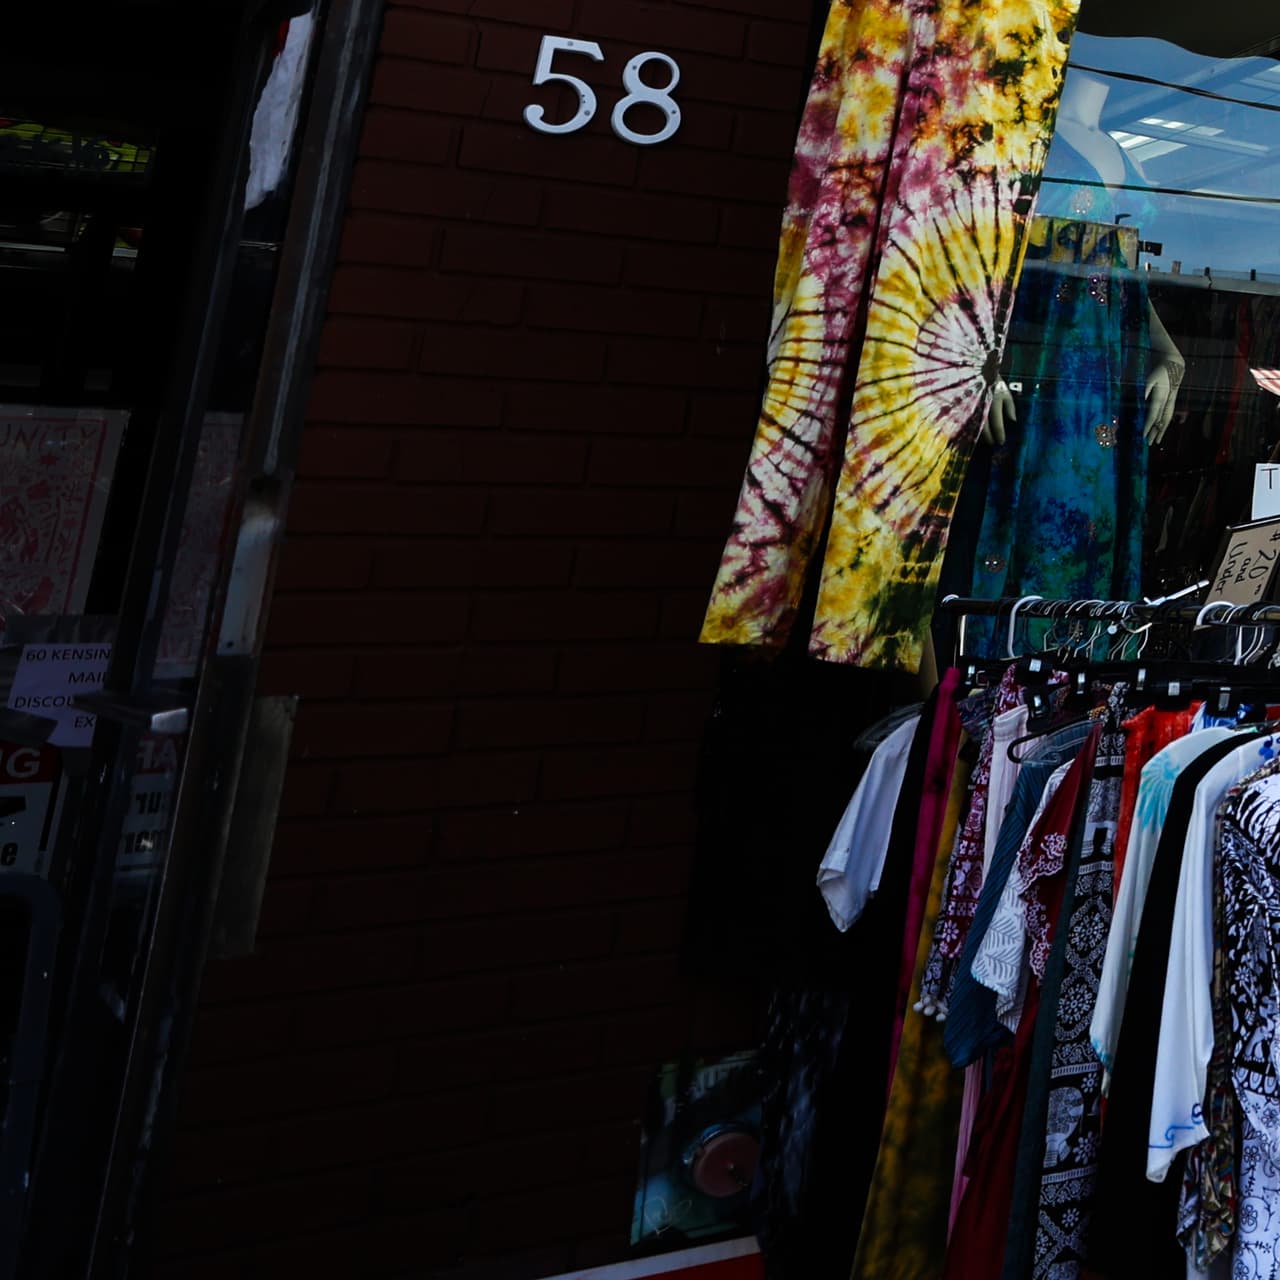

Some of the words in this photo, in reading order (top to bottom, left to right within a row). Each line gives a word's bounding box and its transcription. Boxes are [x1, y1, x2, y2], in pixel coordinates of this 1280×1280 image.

[522, 34, 682, 146] 58
[1234, 558, 1251, 584] and
[26, 648, 47, 662] 60
